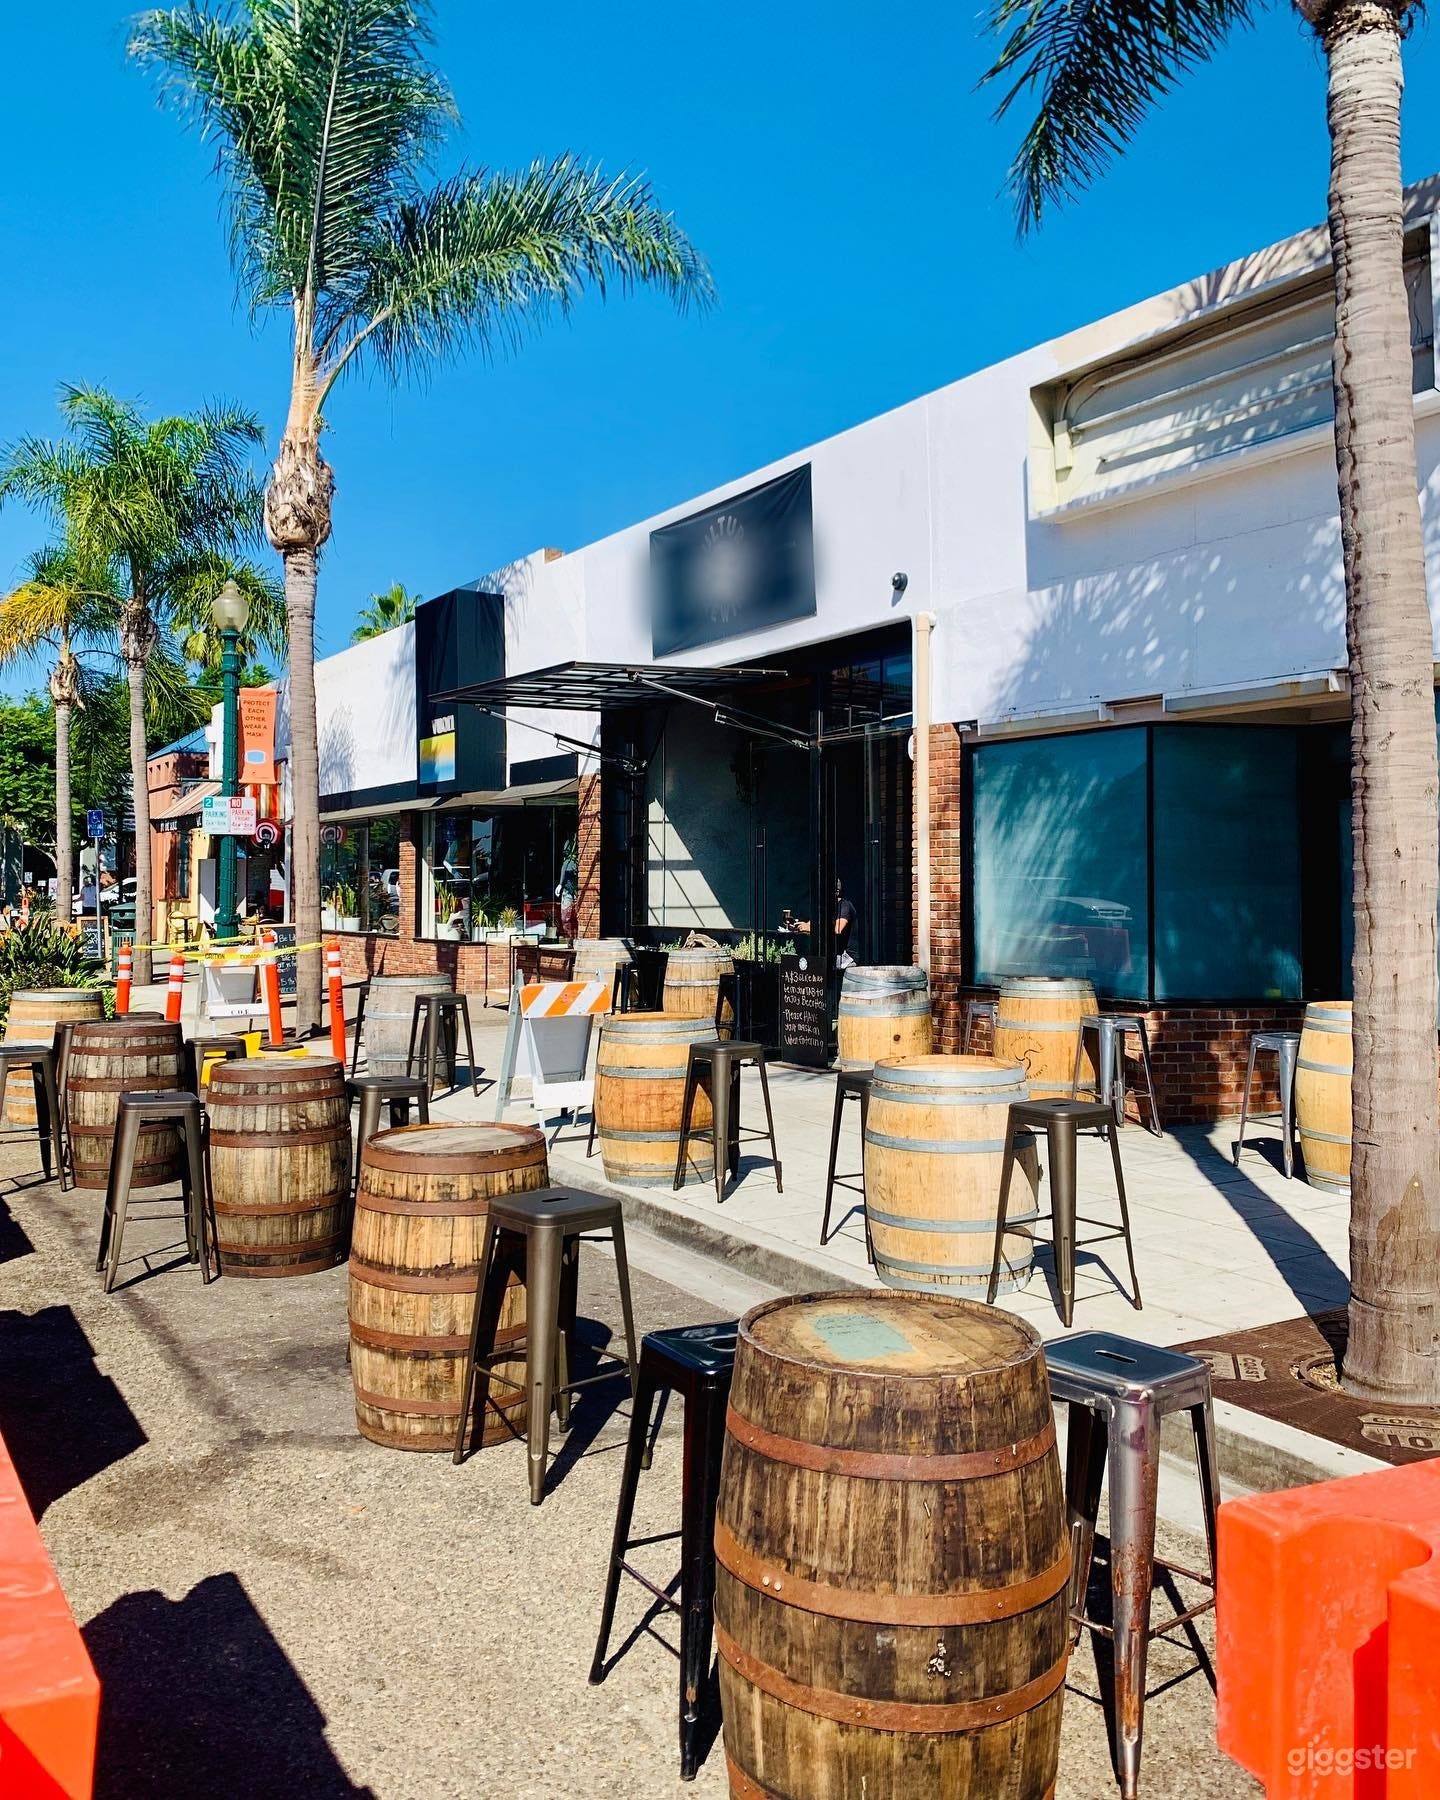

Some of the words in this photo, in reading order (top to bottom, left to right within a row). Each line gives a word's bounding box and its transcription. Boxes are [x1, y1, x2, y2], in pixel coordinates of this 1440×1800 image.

[231, 799, 241, 808] NO
[232, 809, 254, 817] PARKING
[1243, 1357, 1260, 1379] COAST
[1372, 1417, 1435, 1427] COAS
[1387, 1434, 1434, 1448] 10
